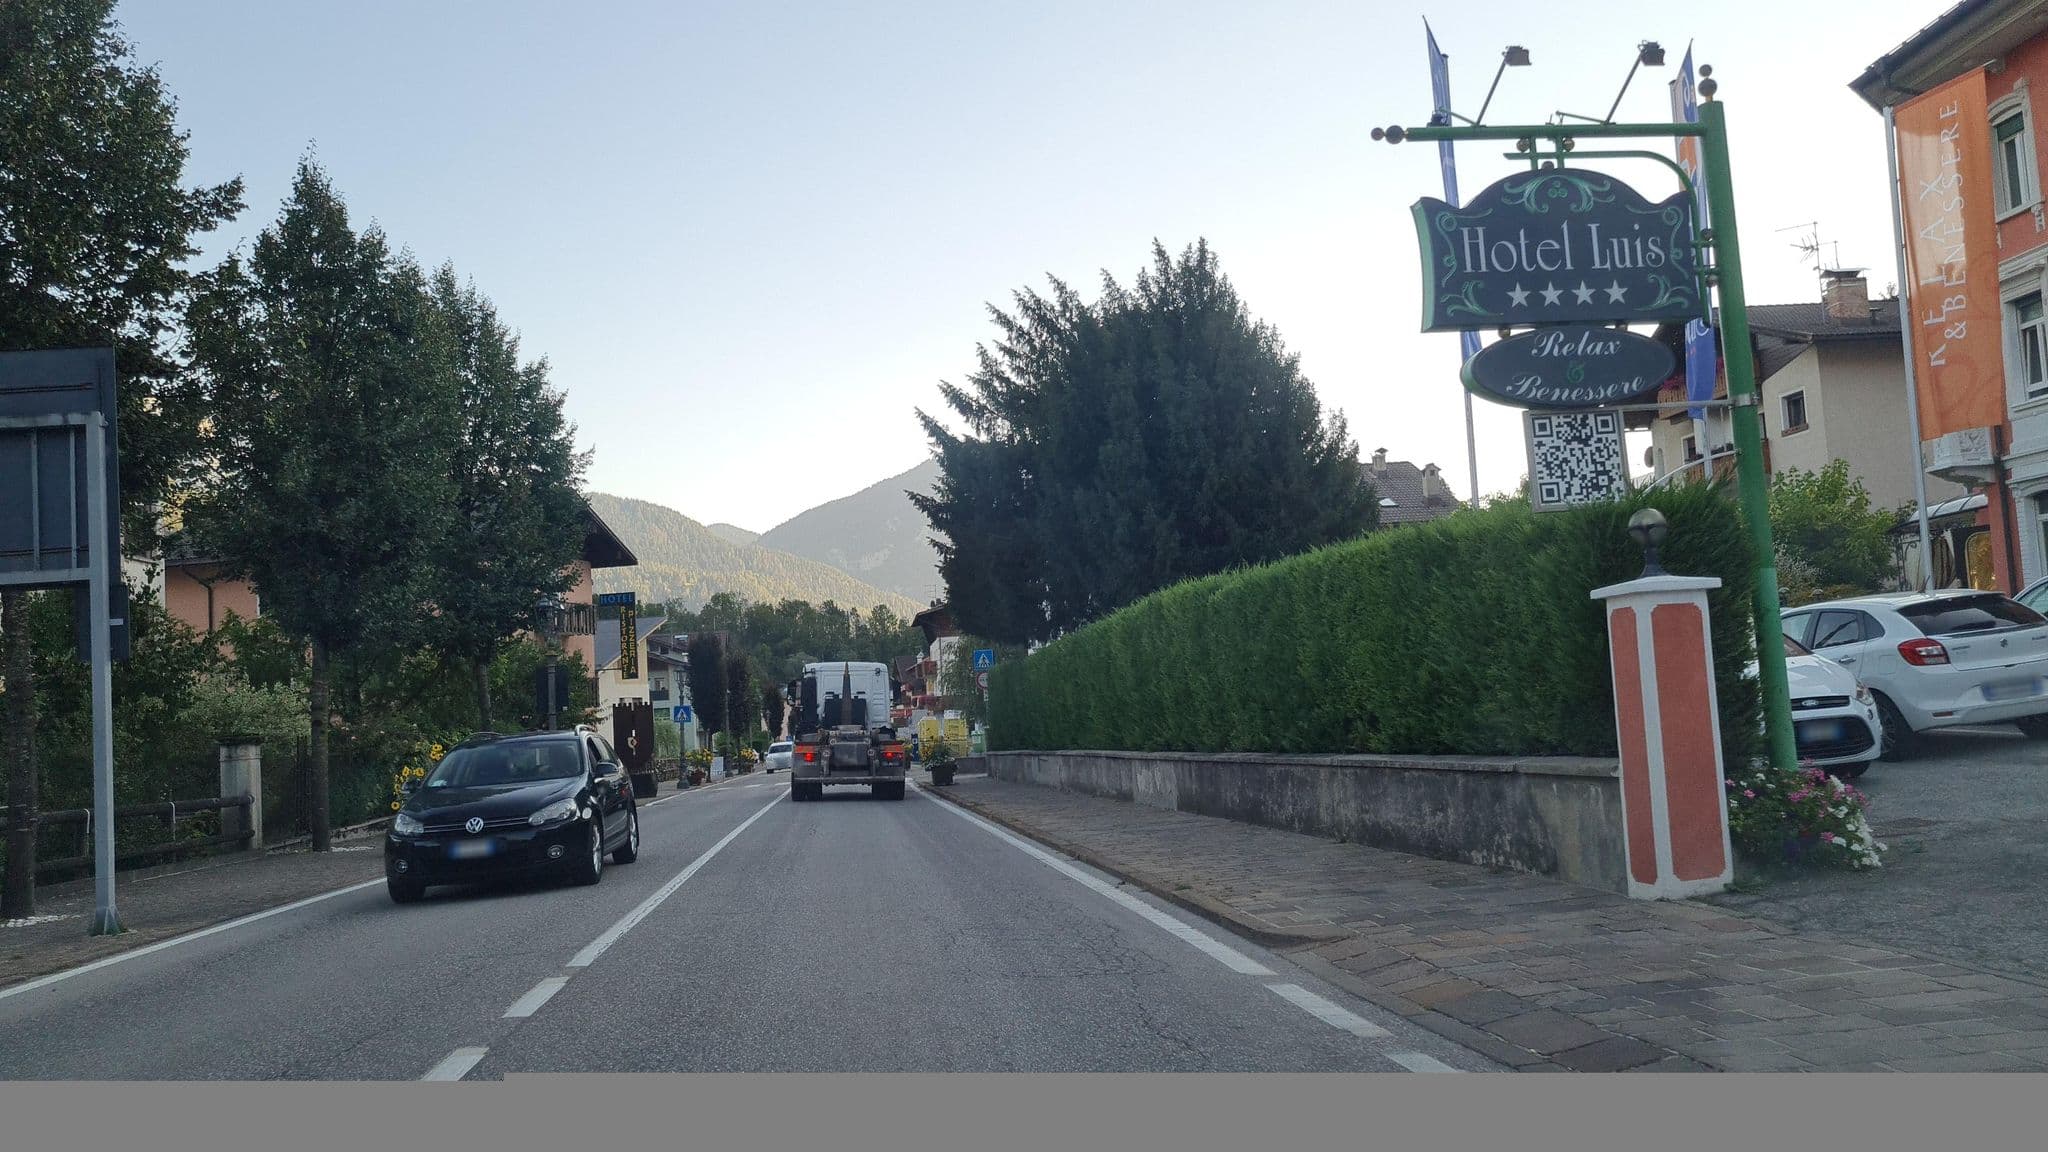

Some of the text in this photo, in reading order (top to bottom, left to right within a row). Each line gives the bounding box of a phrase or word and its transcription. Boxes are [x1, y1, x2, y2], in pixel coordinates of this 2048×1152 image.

[1939, 99, 1968, 340] & BENESSERE
[1460, 220, 1666, 274] Hotel Luis
[1531, 331, 1622, 358] Relax
[1506, 374, 1646, 402] Benessere
[600, 594, 634, 604] HOTEL
[621, 606, 629, 679] RISTORANTE
[628, 610, 636, 673] PIZZERIA
